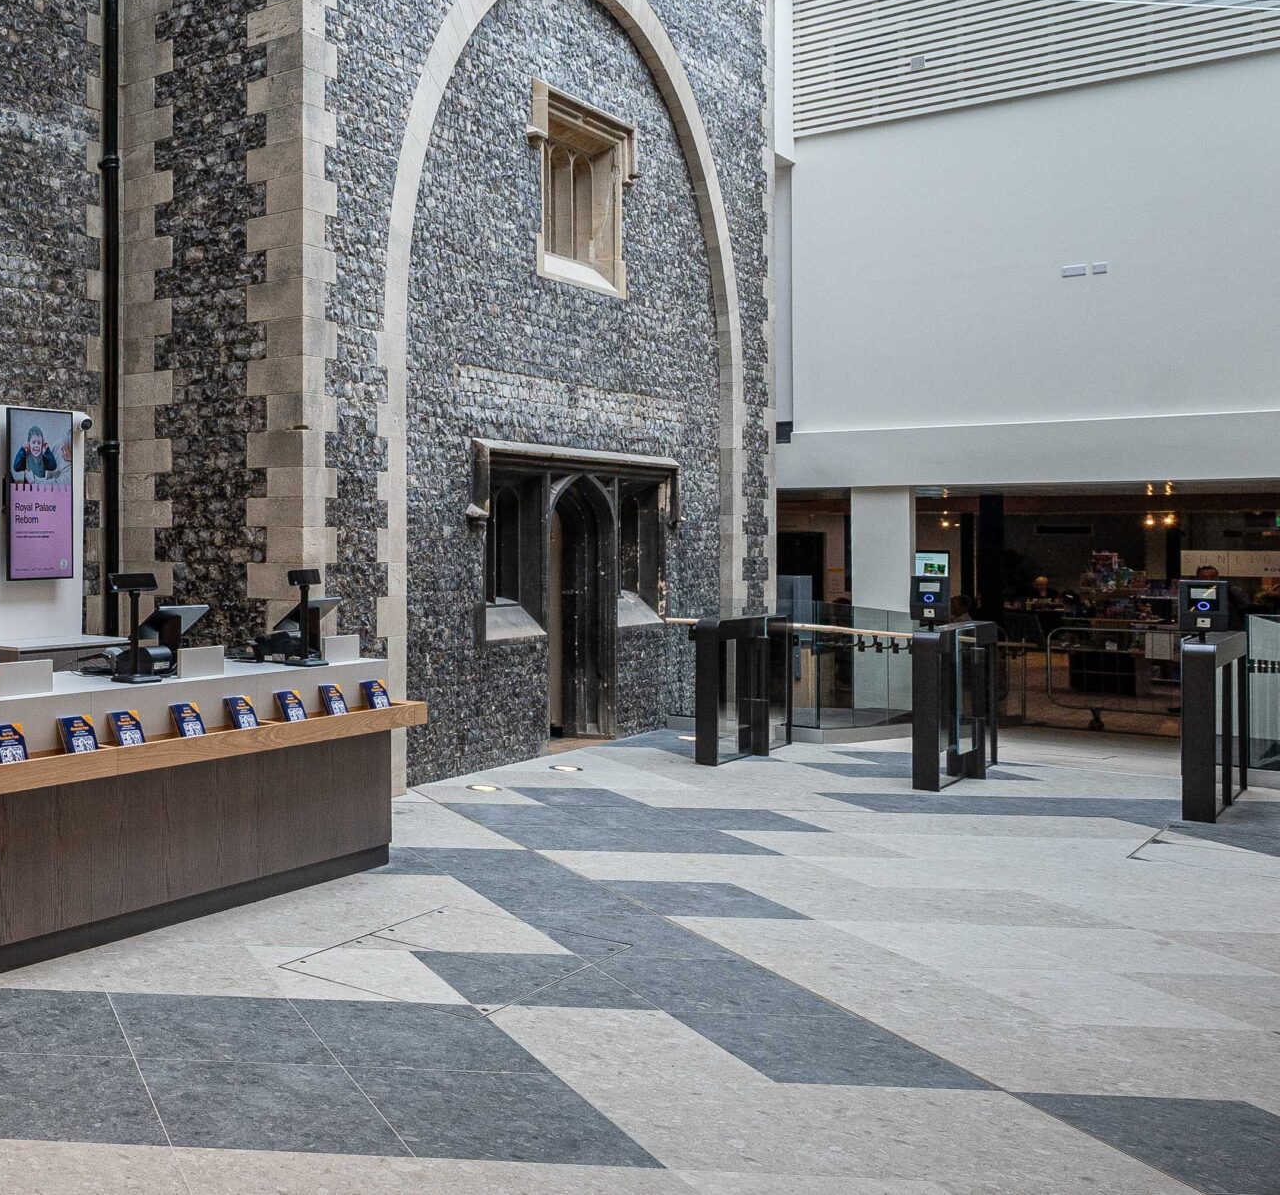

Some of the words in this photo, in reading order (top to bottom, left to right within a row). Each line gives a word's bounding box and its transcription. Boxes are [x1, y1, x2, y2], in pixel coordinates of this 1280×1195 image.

[15, 503, 33, 513] Royal
[35, 503, 57, 512] Palace
[15, 515, 39, 524] Reborn
